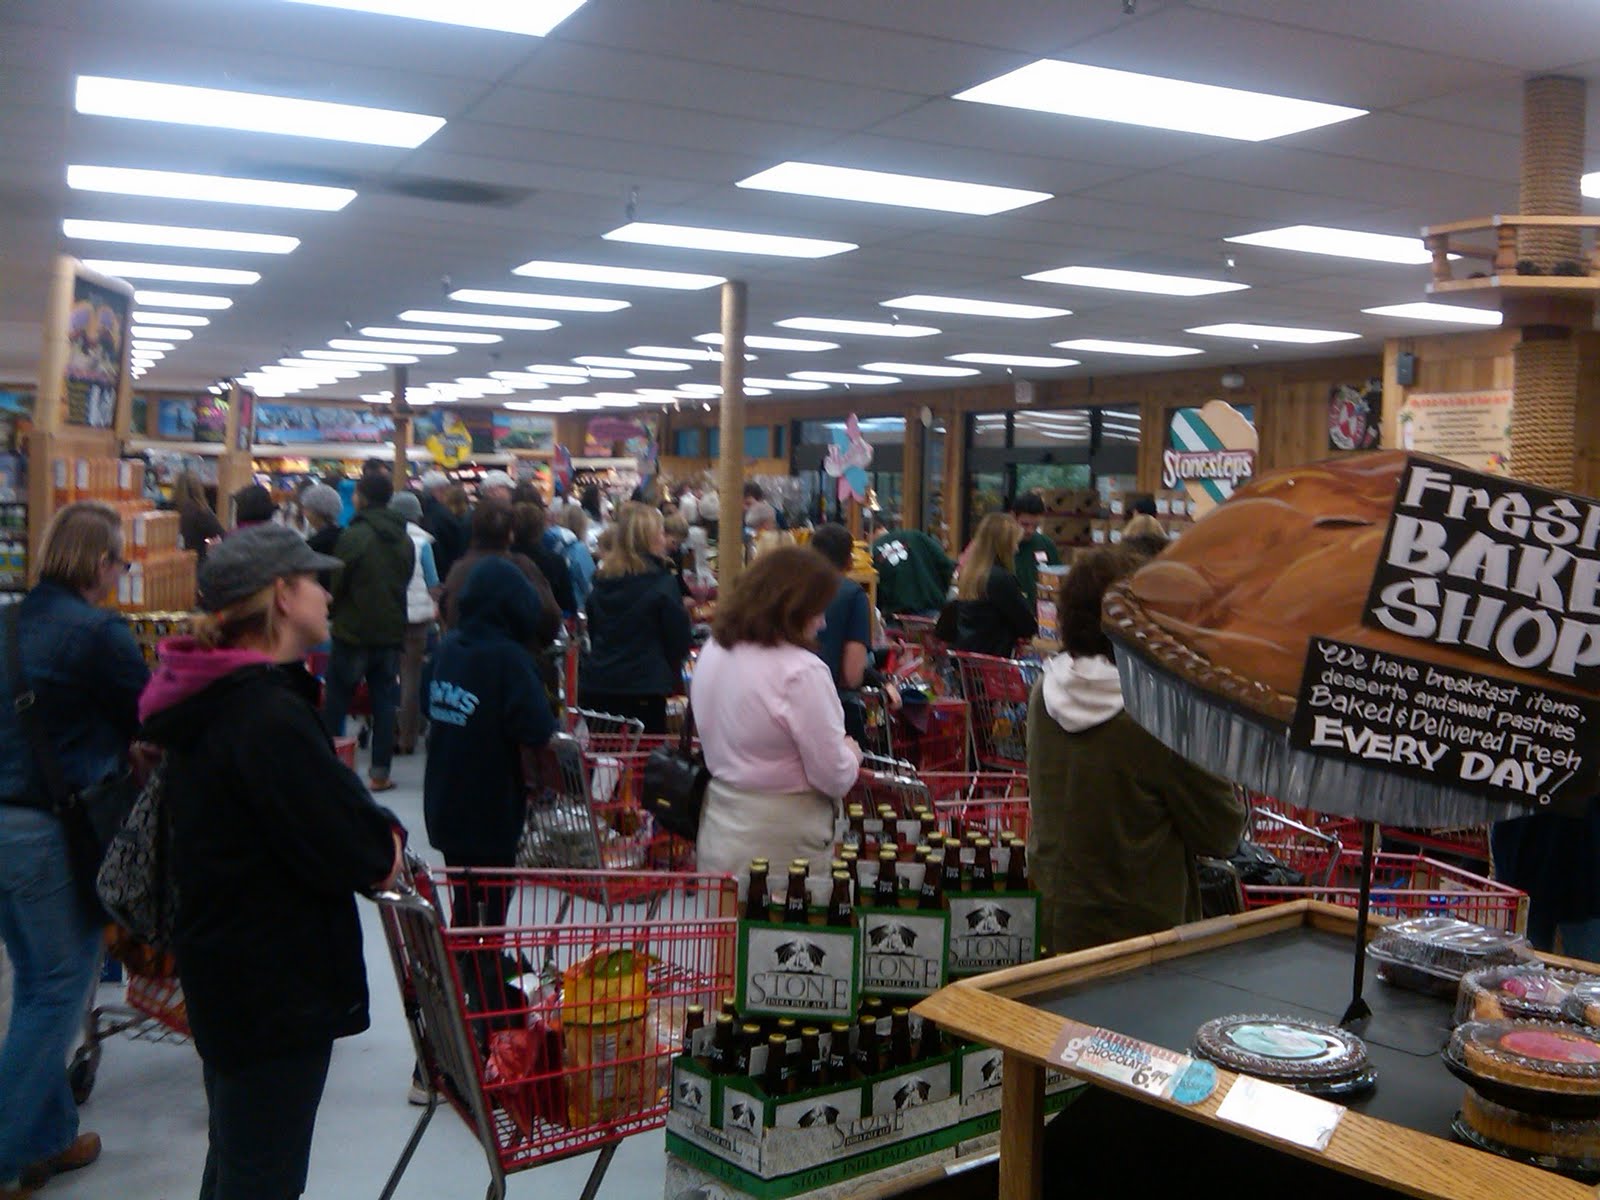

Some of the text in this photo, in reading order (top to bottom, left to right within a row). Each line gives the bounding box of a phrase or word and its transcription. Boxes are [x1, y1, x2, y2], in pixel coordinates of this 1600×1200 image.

[1162, 449, 1254, 488] Stonesteps
[1386, 512, 1600, 616] BAKE
[1371, 577, 1600, 678] SHOP
[1317, 641, 1368, 671] We
[1372, 653, 1420, 681] have
[1425, 666, 1521, 706] breakfast
[1321, 666, 1409, 701] desserts
[1496, 710, 1577, 742] pastries
[1308, 684, 1395, 725] Baked
[1409, 708, 1507, 753] Delivered
[1510, 733, 1583, 771] Fresh
[1310, 714, 1575, 806] EVERY DAY!
[749, 972, 849, 1011] STONE
[865, 954, 939, 988] TONE
